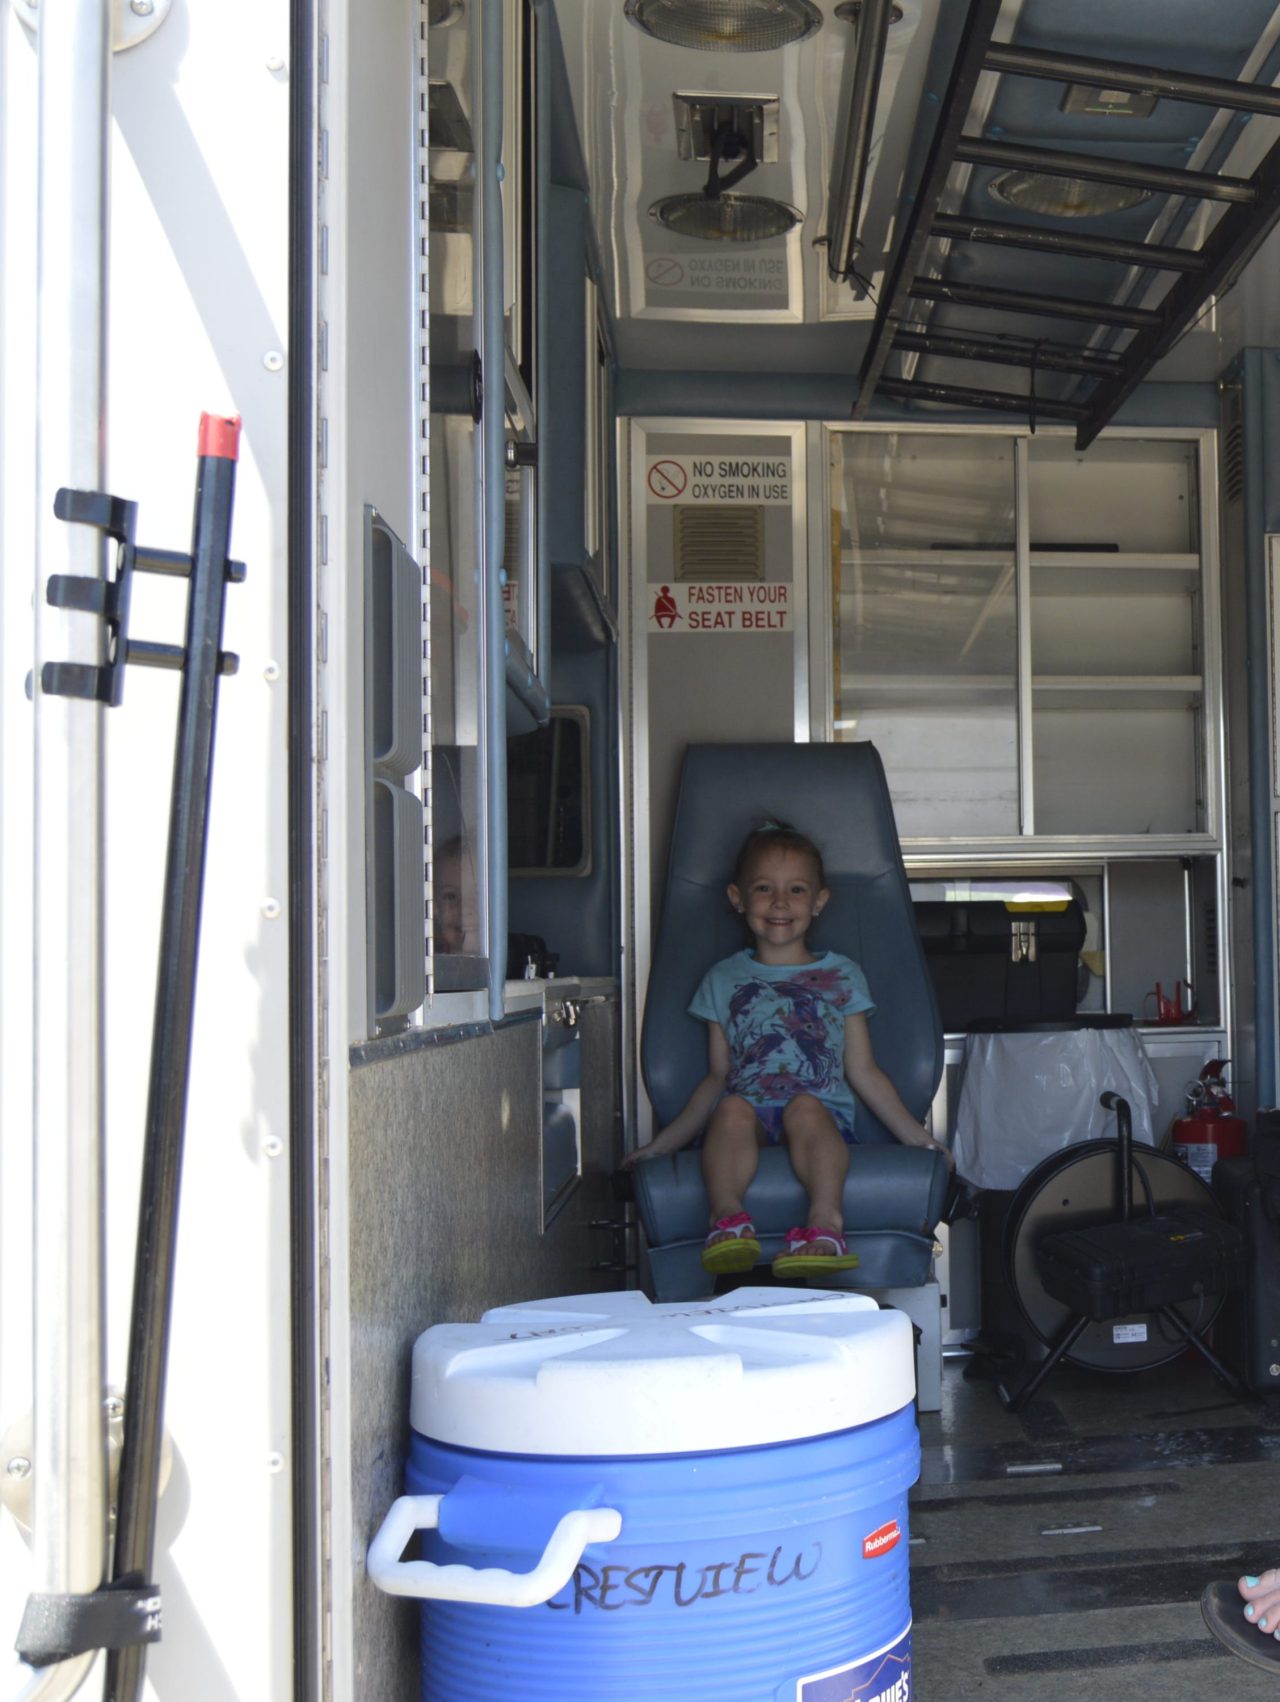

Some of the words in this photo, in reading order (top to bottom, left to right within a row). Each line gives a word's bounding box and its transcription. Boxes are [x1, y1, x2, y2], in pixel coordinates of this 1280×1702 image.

[693, 461, 714, 478] NO
[718, 461, 787, 479] SMOKING
[692, 483, 744, 499] OXYGEN
[747, 484, 760, 499] IN
[763, 484, 788, 500] USE
[688, 585, 743, 604] FASTEN
[748, 585, 788, 604] YOUR
[688, 611, 736, 629] SEAT
[742, 611, 787, 629] BELT
